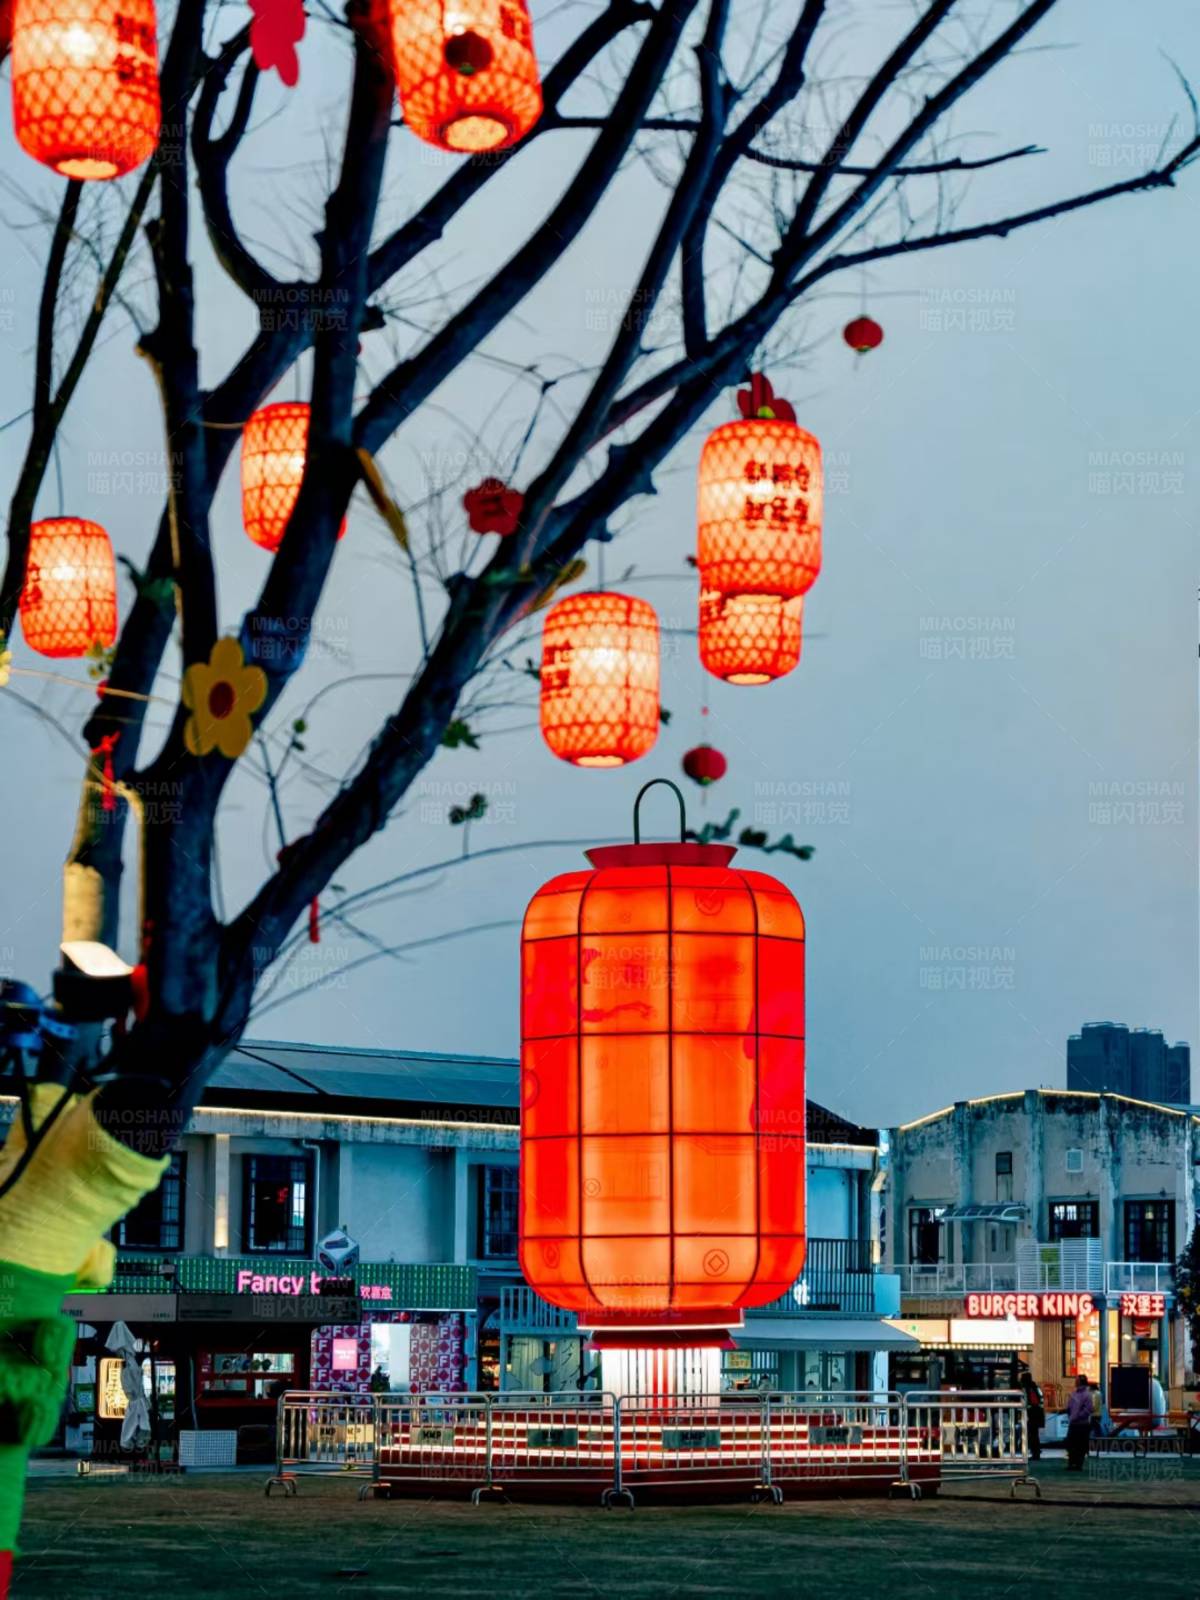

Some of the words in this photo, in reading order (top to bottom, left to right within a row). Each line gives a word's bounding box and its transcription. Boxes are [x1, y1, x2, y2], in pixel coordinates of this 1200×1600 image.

[237, 1270, 304, 1296] Fancy
[968, 1294, 1039, 1316] BURGER
[1042, 1294, 1093, 1316] KING
[1122, 1294, 1165, 1316] 汉堡王
